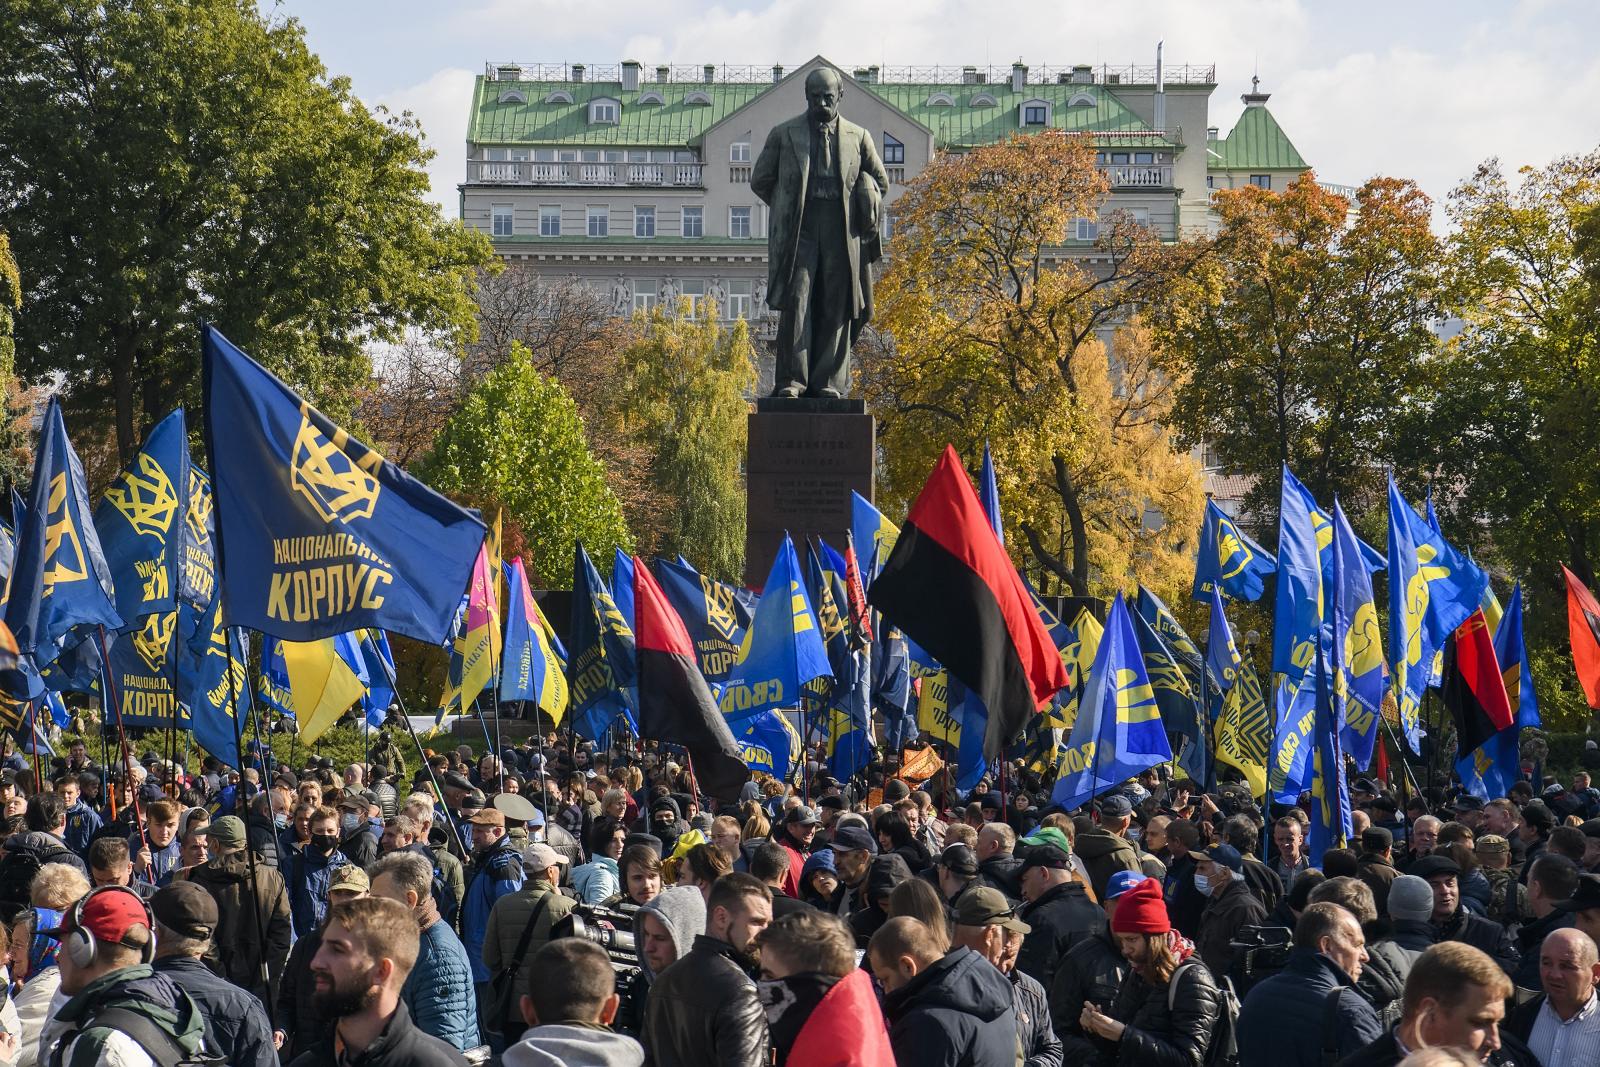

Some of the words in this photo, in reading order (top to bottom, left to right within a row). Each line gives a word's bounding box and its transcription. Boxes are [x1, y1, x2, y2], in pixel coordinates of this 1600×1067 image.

[267, 563, 393, 622] КОРПУС
[698, 640, 741, 655] НАЦІОНАЛ
[124, 674, 171, 691] НАЦІОНАЛ
